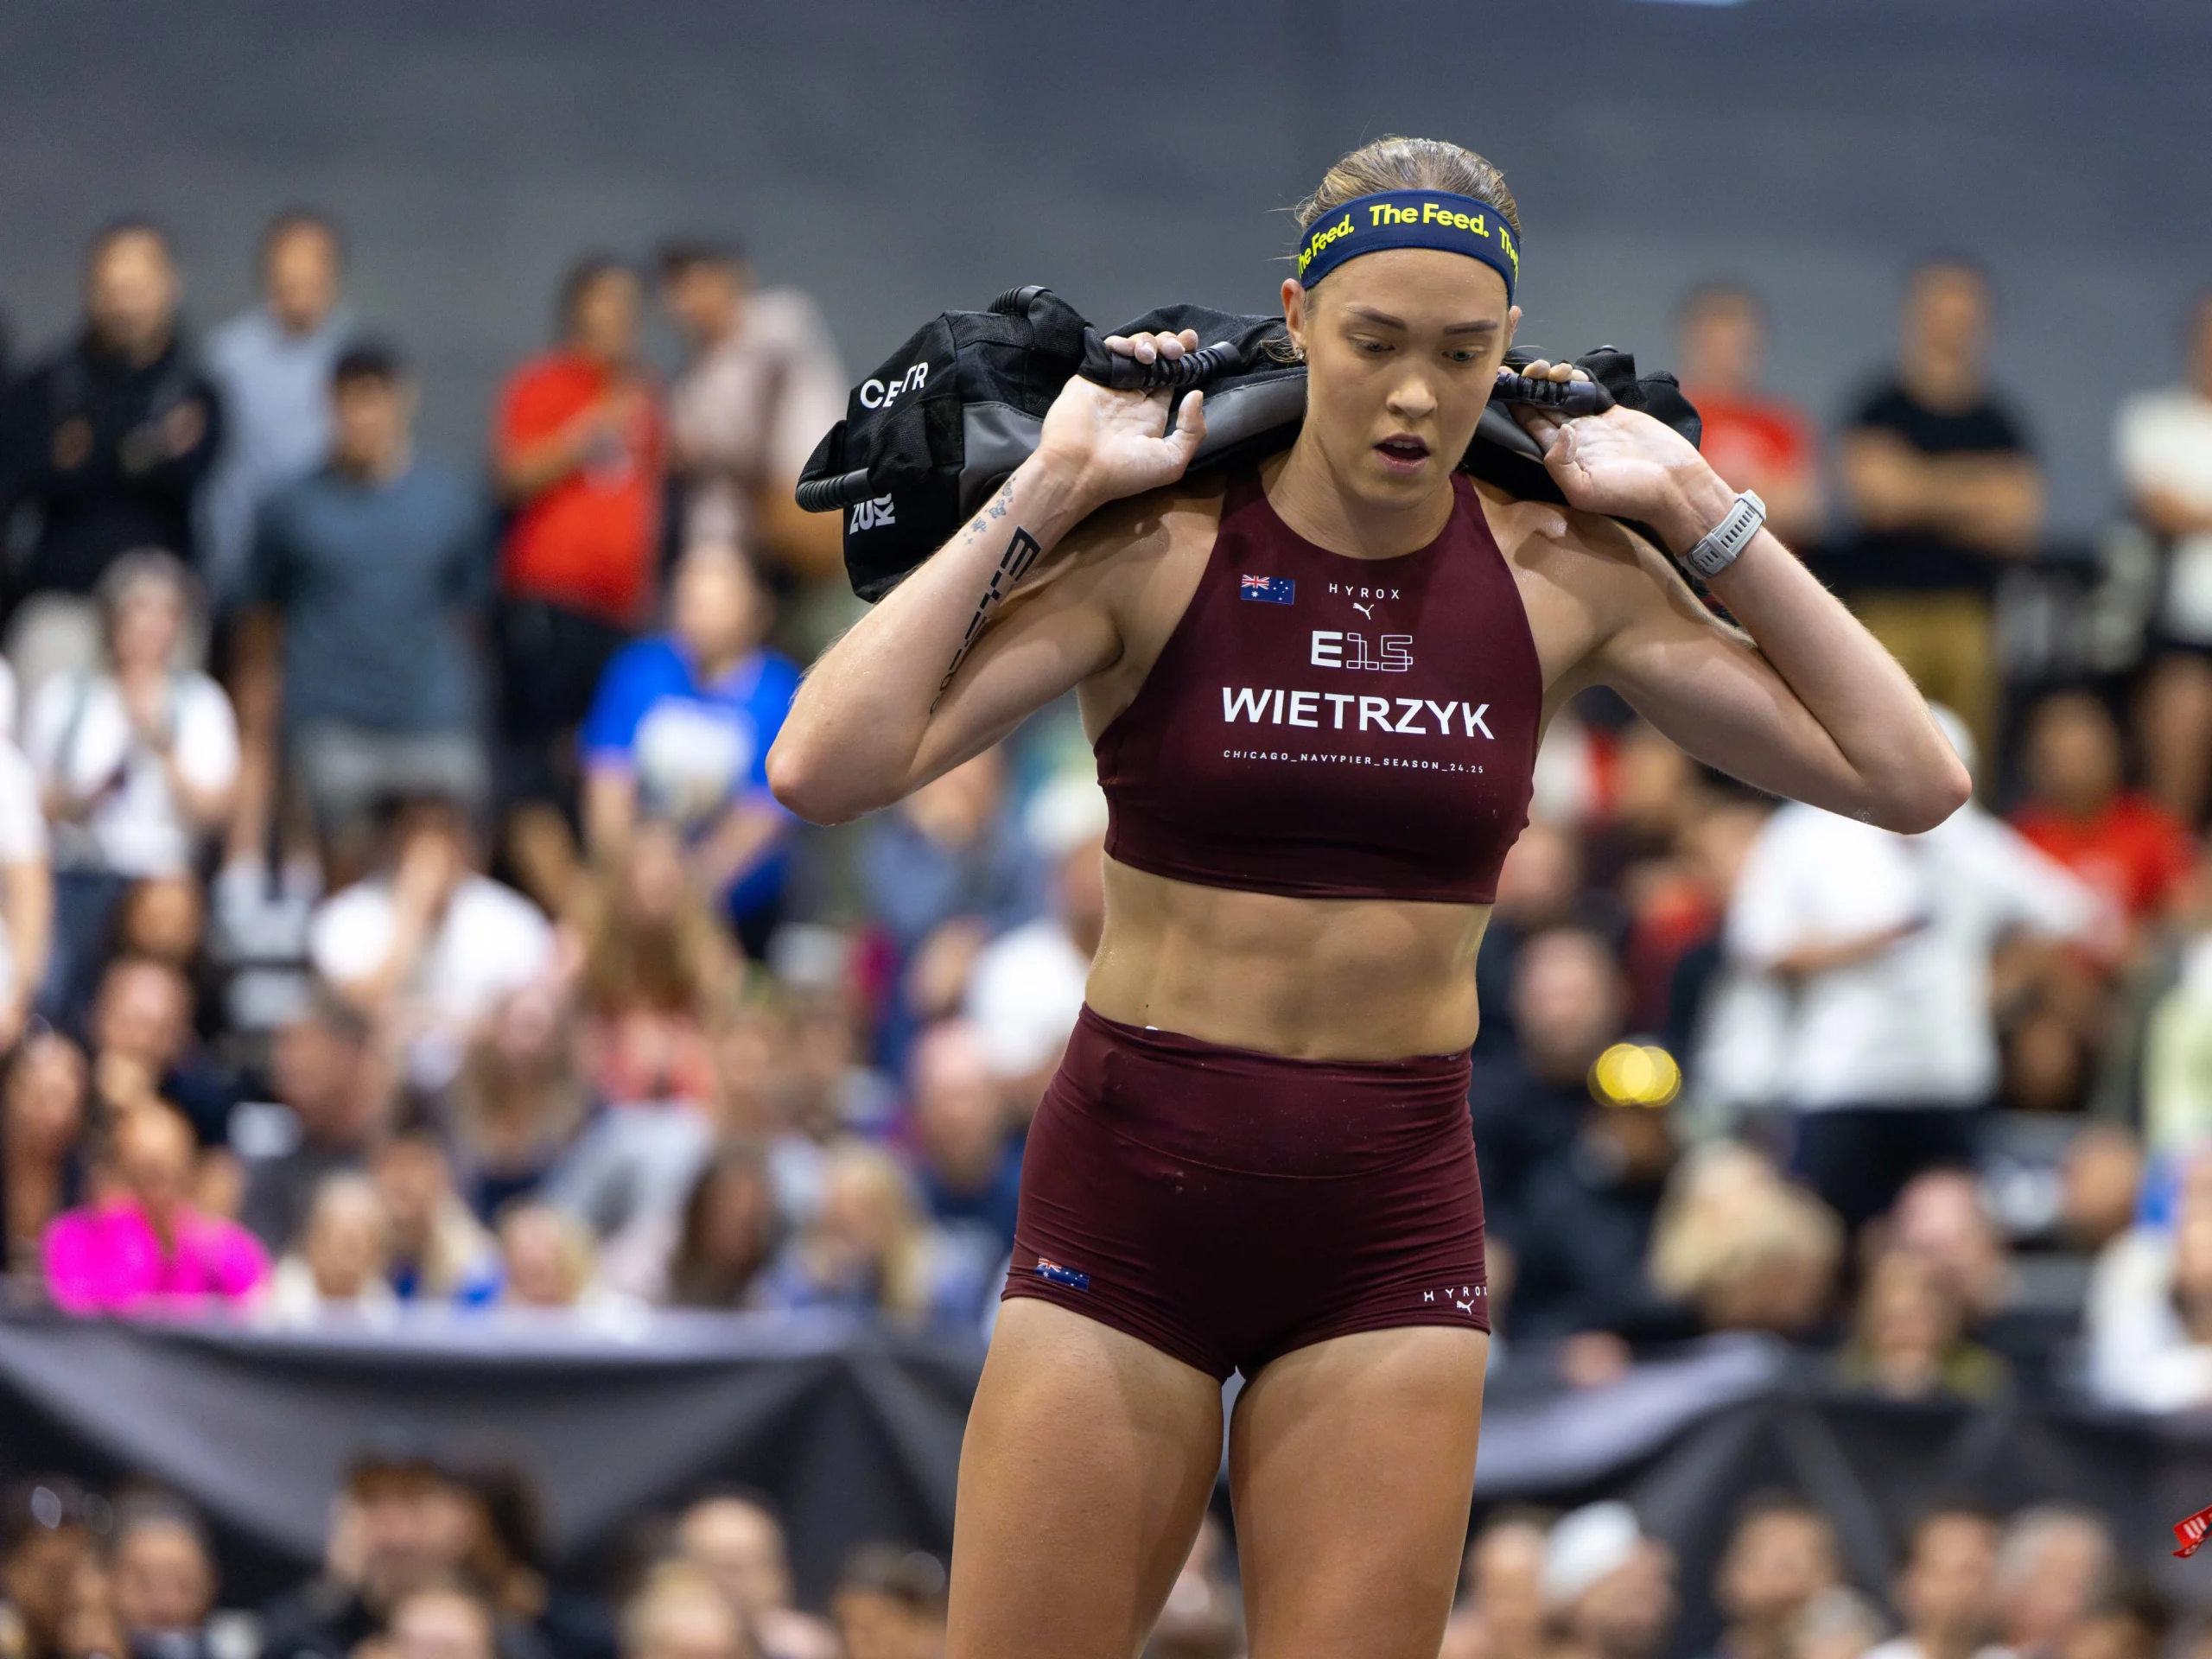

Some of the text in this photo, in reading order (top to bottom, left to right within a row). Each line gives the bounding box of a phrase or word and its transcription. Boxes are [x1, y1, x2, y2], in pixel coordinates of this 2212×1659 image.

[1312, 213, 1355, 257] Feed.
[1369, 203, 1490, 238] The Feed.
[1329, 582, 1400, 600] HYROX
[1310, 630, 1414, 672] E15
[1222, 687, 1495, 740] WIETRZYK
[1223, 749, 1484, 773] CHICAGO_NAVYPIER_SEASON_24.25
